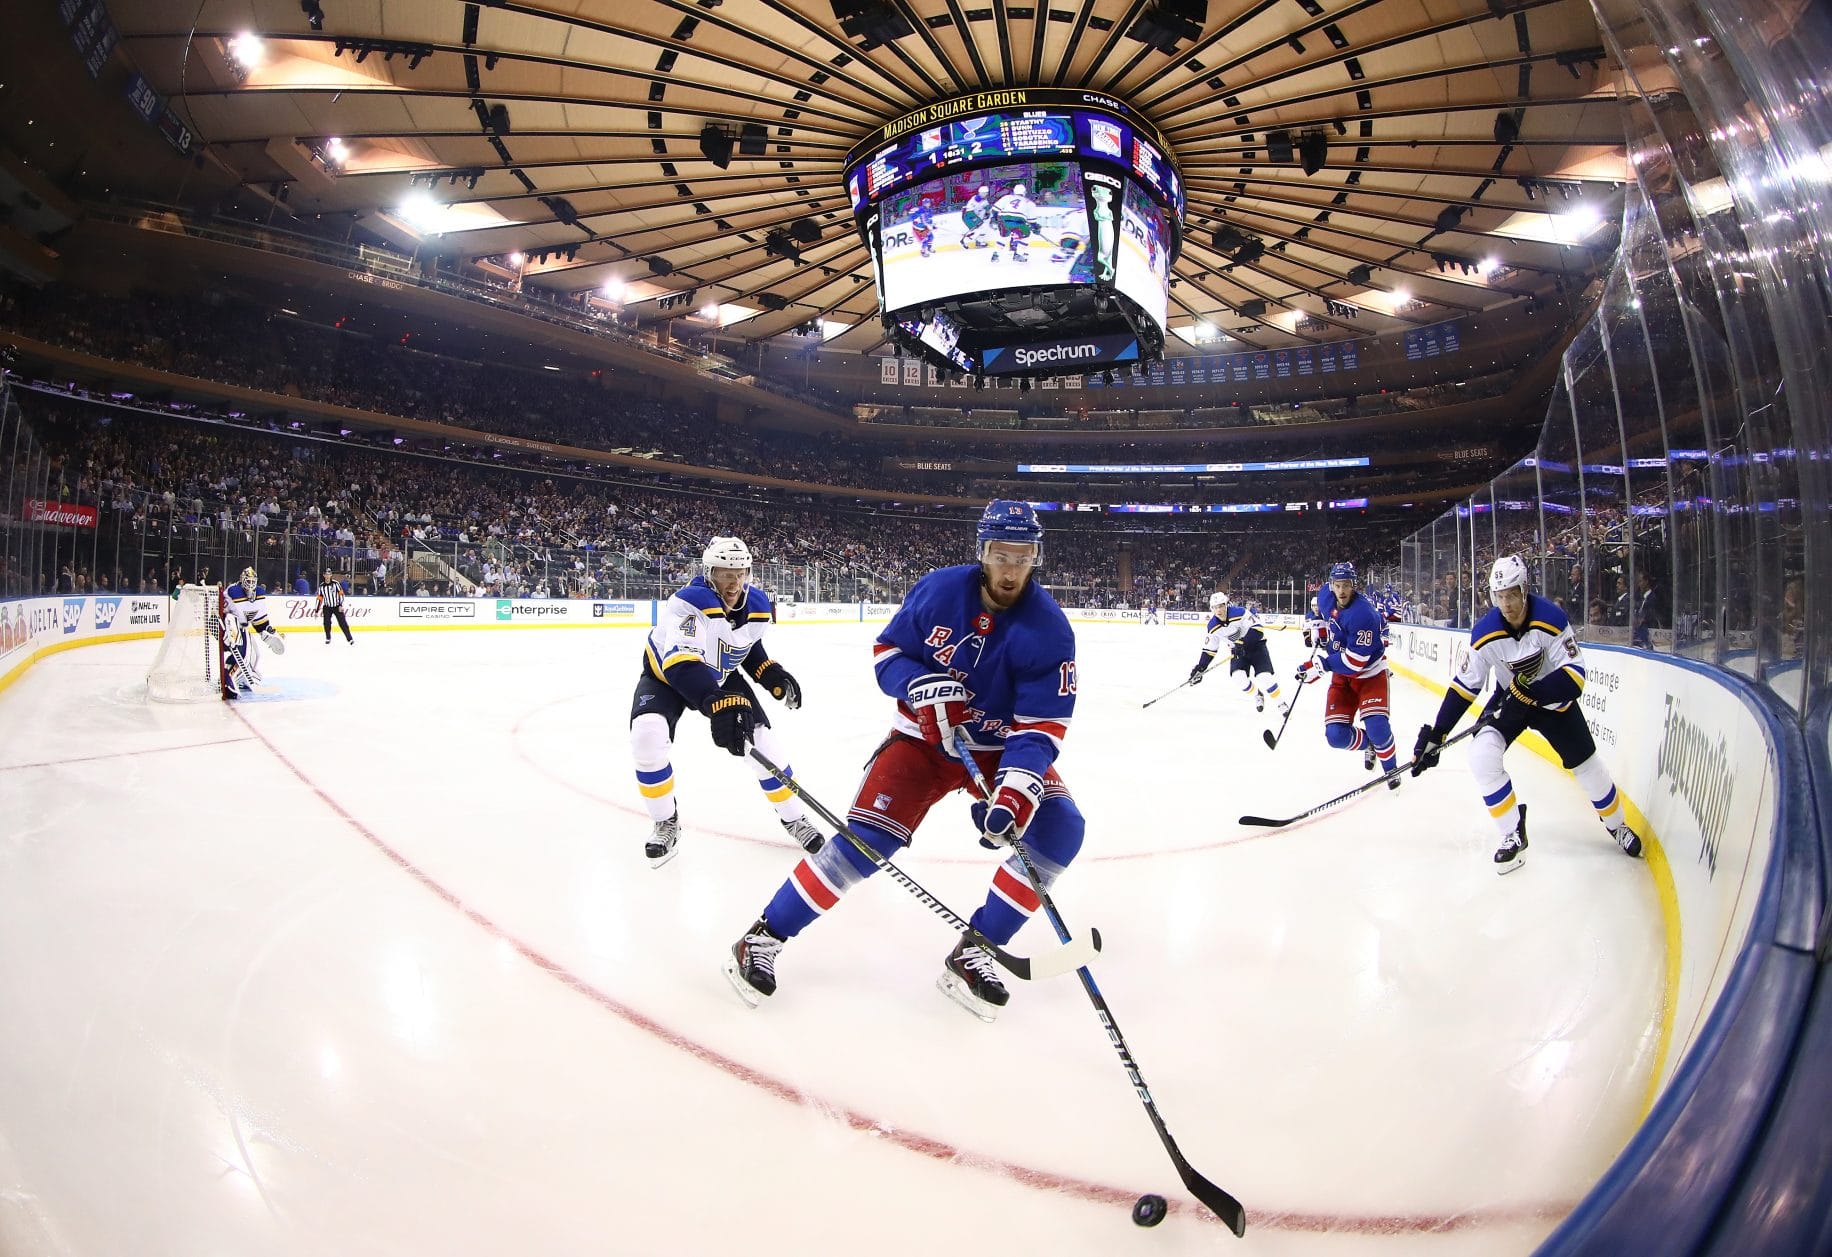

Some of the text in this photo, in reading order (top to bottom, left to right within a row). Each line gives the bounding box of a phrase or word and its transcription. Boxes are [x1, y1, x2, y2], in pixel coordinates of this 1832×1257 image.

[1083, 94, 1120, 109] CHASE
[883, 91, 1027, 140] MADISON SQUARE GARDEN
[928, 152, 937, 164] 1
[971, 142, 983, 154] 2
[1084, 172, 1121, 189] GEICO
[348, 272, 374, 284] CHASE
[1015, 344, 1097, 366] Spectrum
[884, 365, 896, 376] 10
[906, 367, 918, 378] 12
[1454, 447, 1488, 459] BLUE SEATS
[917, 462, 952, 471] BLUE SEATS
[1495, 570, 1503, 579] 55
[63, 604, 81, 627] SAP
[95, 603, 117, 624] SAP
[286, 599, 373, 619] Buiser
[500, 604, 568, 616] enterprise
[867, 606, 891, 615] Spectrum
[1165, 612, 1200, 621] GEICO
[34, 607, 59, 634] DELTA
[129, 614, 160, 625] WATCH LIVE
[679, 614, 698, 638] 4
[1356, 630, 1373, 646] 28
[1415, 639, 1438, 662] LEXUS
[1058, 661, 1078, 697] 13
[1585, 667, 1620, 692] xchange
[1361, 698, 1382, 706] CCM
[1580, 692, 1607, 713] raded
[877, 858, 969, 935] WARRIOR
[1096, 1009, 1153, 1104] BAUER
